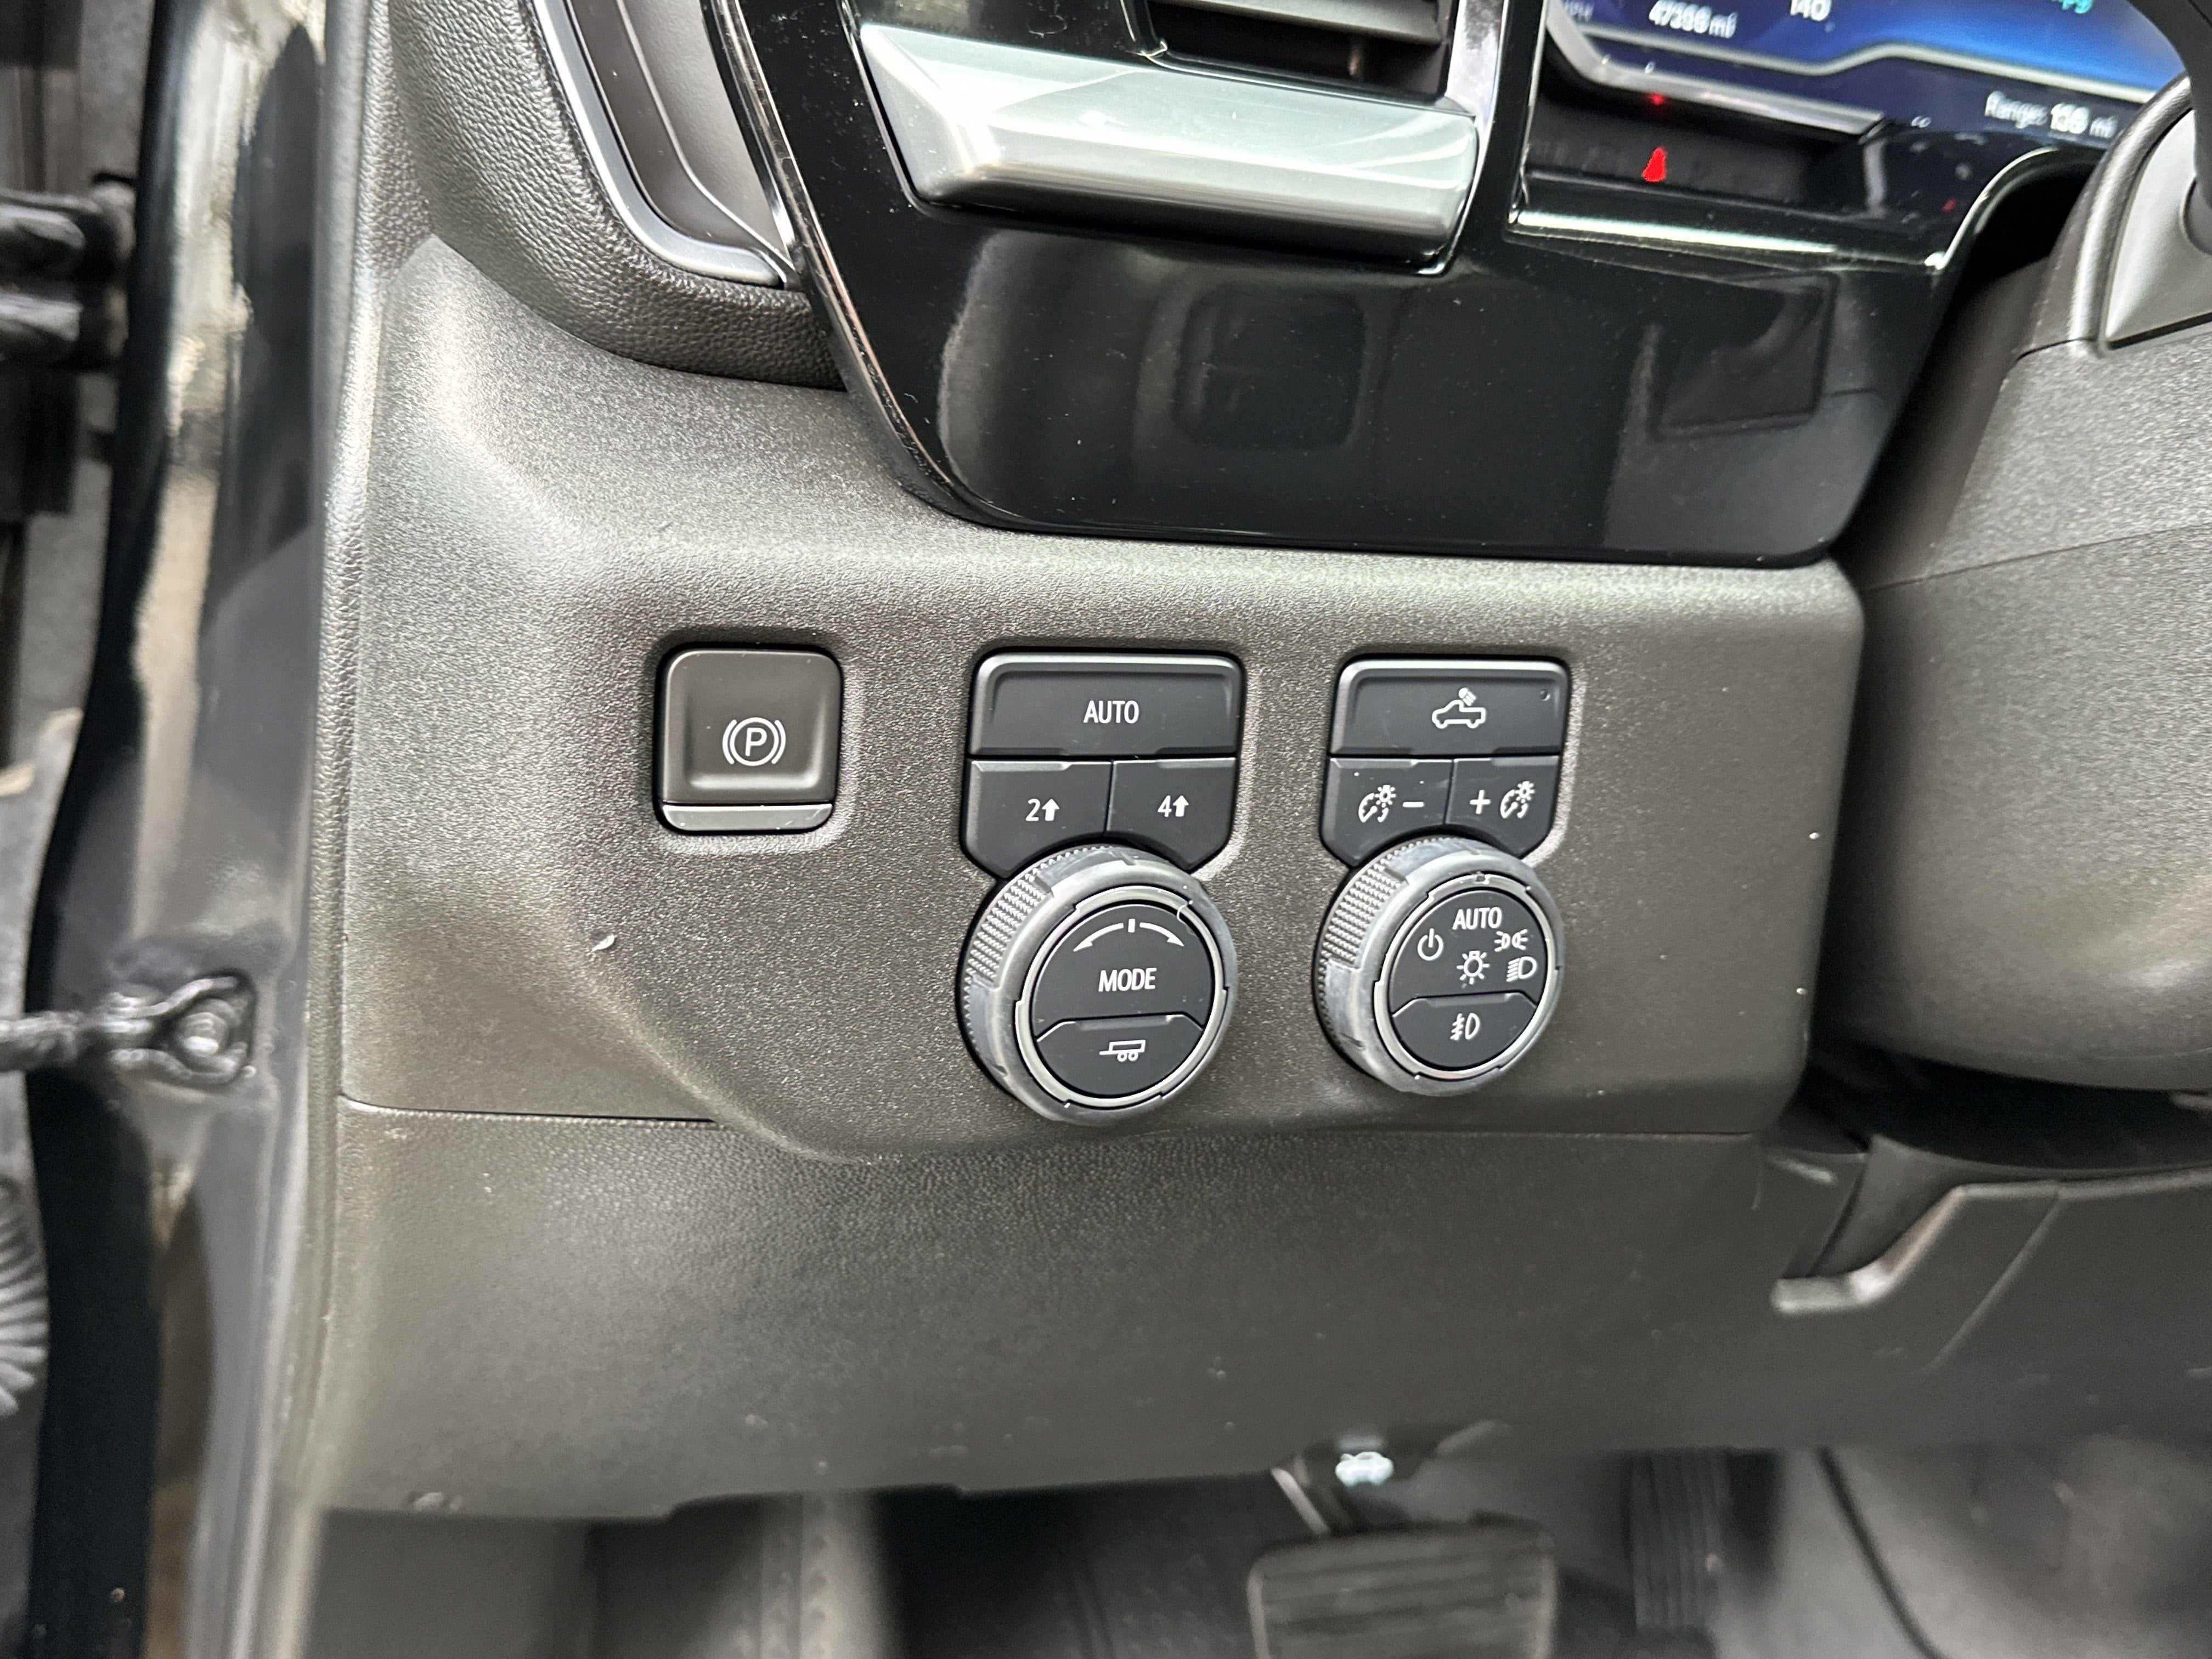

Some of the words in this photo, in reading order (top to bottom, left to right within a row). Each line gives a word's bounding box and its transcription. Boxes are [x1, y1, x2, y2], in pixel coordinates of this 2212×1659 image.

[1083, 700, 1139, 724] AUTO
[1452, 907, 1503, 930] AUTO
[1098, 967, 1157, 992] MODE
